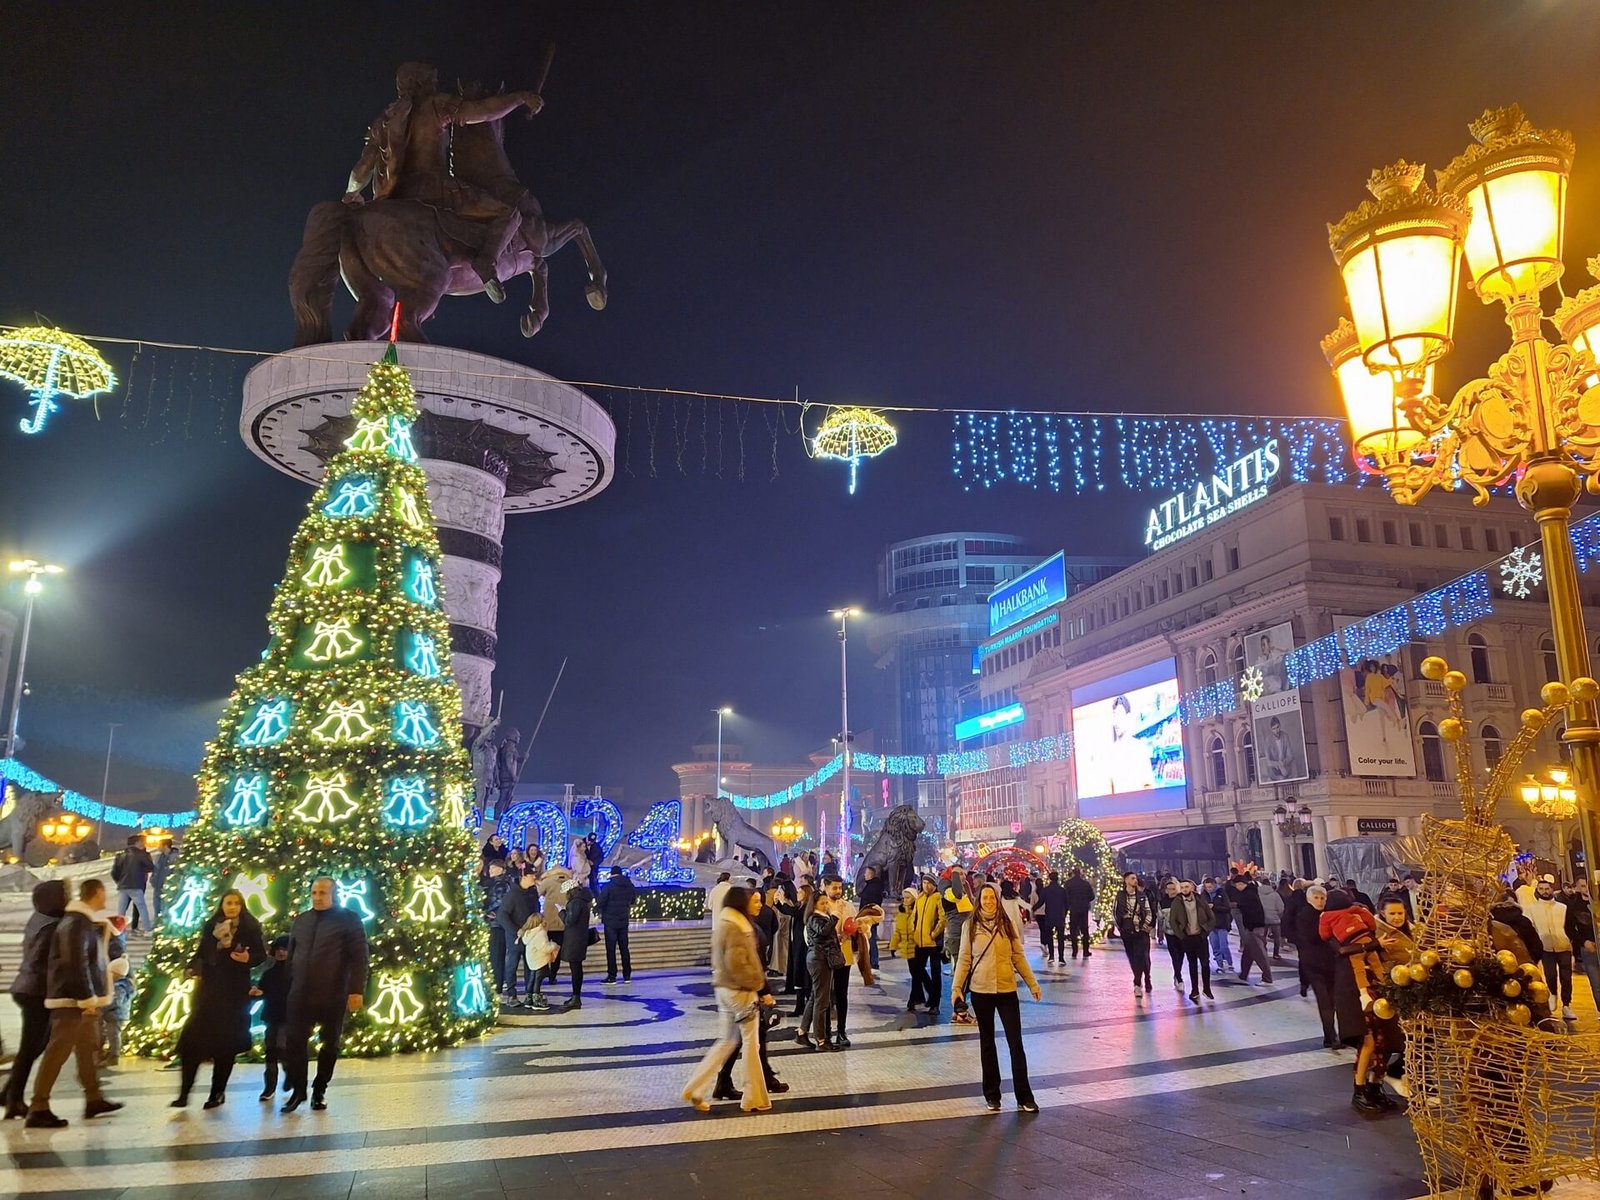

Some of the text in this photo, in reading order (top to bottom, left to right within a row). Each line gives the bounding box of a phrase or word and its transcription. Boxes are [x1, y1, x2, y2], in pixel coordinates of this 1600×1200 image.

[1144, 439, 1280, 545] ATLANTIS
[1153, 485, 1268, 551] CHOCOLATE SEA SHELLS
[1000, 577, 1048, 618] HALKBANK
[985, 612, 1057, 653] TURKISH MAARIF FOUNDATION
[1255, 695, 1297, 713] CALLIOPE
[1358, 757, 1408, 766] Color your life.
[465, 799, 697, 884] 024
[1360, 821, 1396, 829] CALLIOPE
